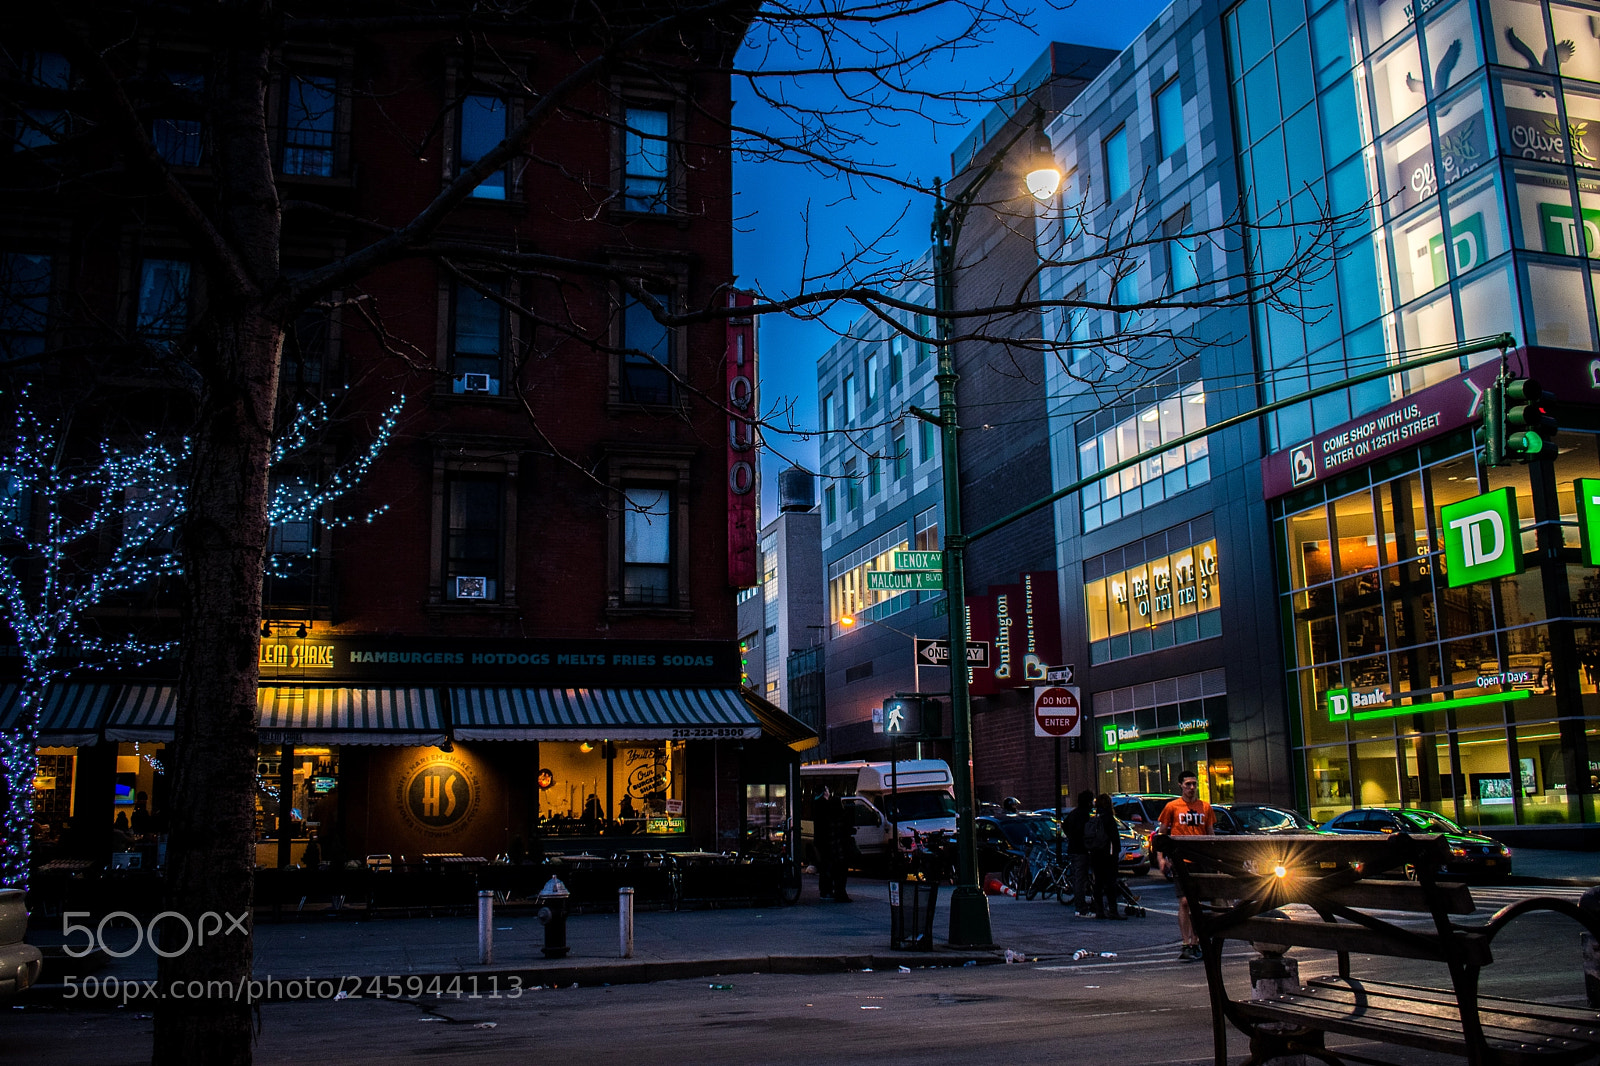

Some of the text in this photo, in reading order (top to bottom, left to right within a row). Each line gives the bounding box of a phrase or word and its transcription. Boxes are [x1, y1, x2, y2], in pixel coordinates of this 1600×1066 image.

[1512, 125, 1564, 154] Olive
[1411, 155, 1455, 192] Olie
[1323, 403, 1421, 453] COME SHOP WITH US,
[1324, 411, 1441, 470] ENTER ON 125TH STREET
[1449, 509, 1505, 568] TD
[898, 553, 941, 568] LENOX AV
[871, 573, 942, 588] MALCOLM X BLVD
[1025, 573, 1033, 615] Everyone
[1027, 629, 1036, 653] Style
[260, 644, 335, 668] LEM SHAKE
[349, 651, 714, 667] HAMBURGERS HOTDOGS MELTS FRIES SODAS
[927, 647, 979, 659] ONE AY
[1049, 672, 1058, 680] ONE
[1476, 671, 1529, 688] Open 7 Days
[1043, 697, 1072, 705] DO NOT
[1330, 688, 1386, 715] TD Bank
[1044, 718, 1070, 727] ENTER
[1179, 721, 1192, 732] Open
[1197, 719, 1209, 729] Days
[672, 729, 744, 737] 212-222-8300
[1105, 727, 1139, 746] TD Bank
[421, 774, 457, 817] HS
[1178, 813, 1205, 825] CPTC
